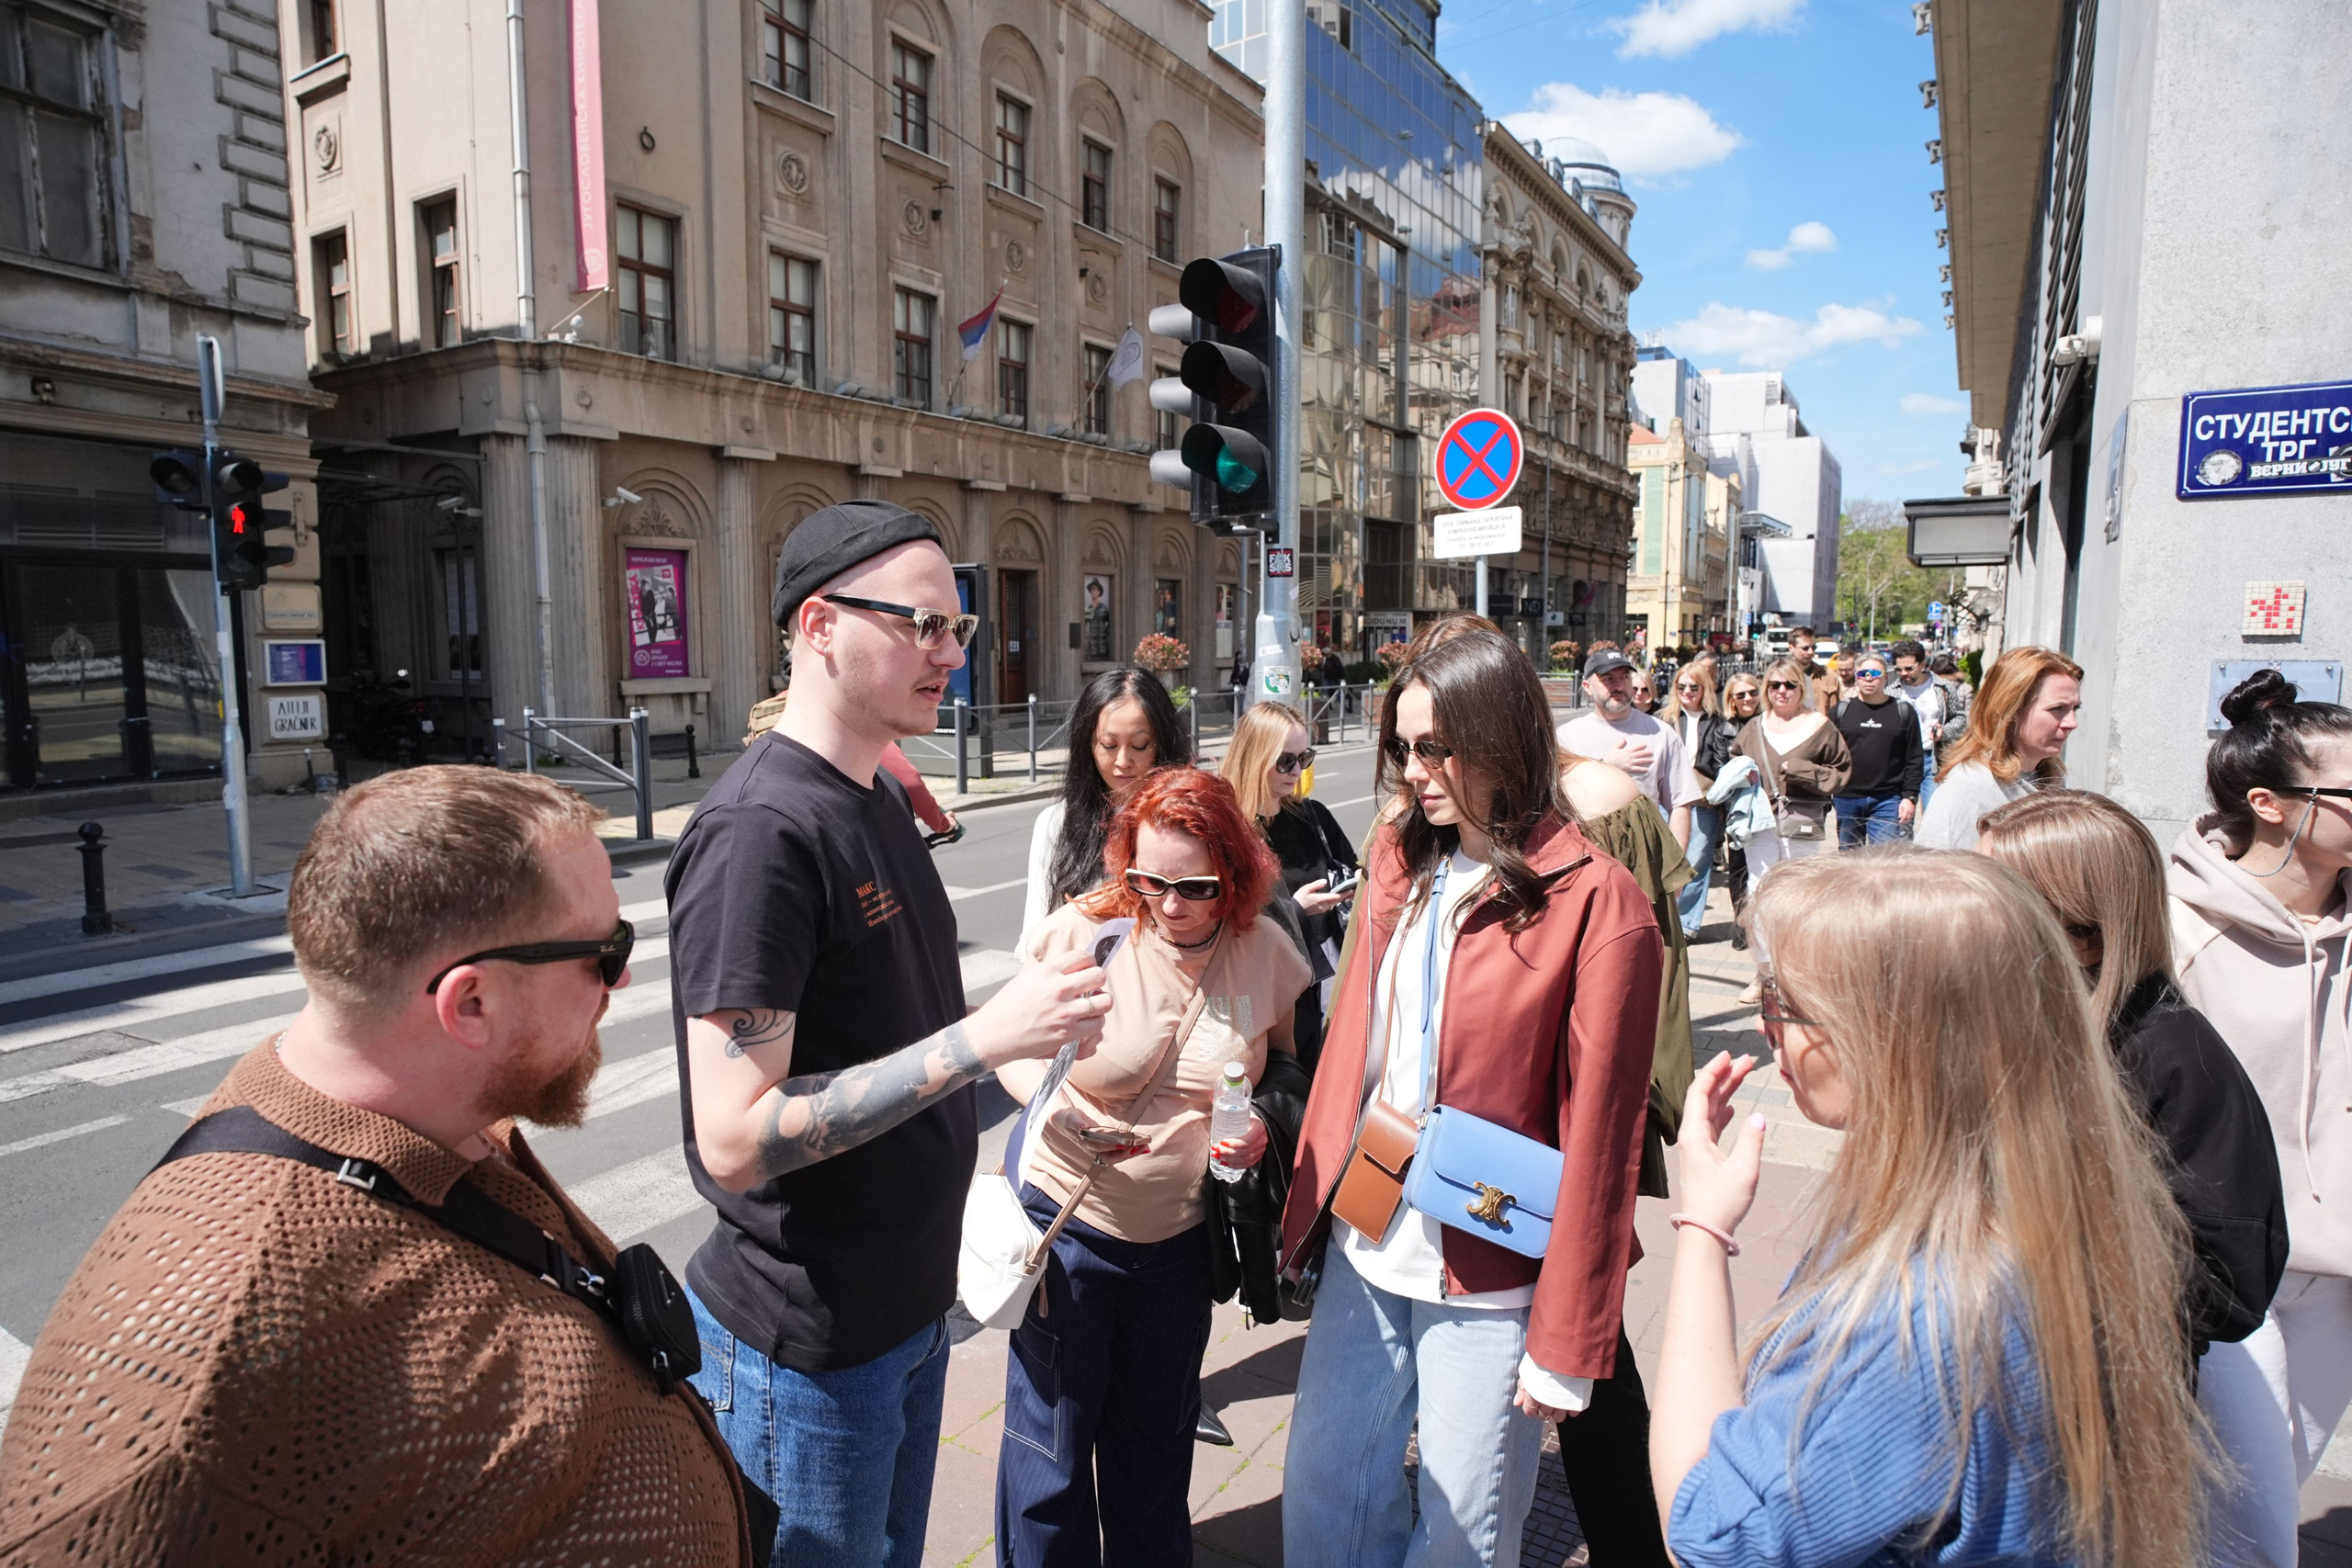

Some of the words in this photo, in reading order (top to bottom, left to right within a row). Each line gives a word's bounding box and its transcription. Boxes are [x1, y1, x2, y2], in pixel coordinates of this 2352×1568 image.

[577, 88, 594, 230] ЈУГОСЛОВЕНСКА
[2195, 406, 2352, 444] СТУДЕНТС
[2261, 439, 2316, 462] ТРГ
[1269, 554, 1291, 563] FK
[1269, 563, 1292, 572] SS
